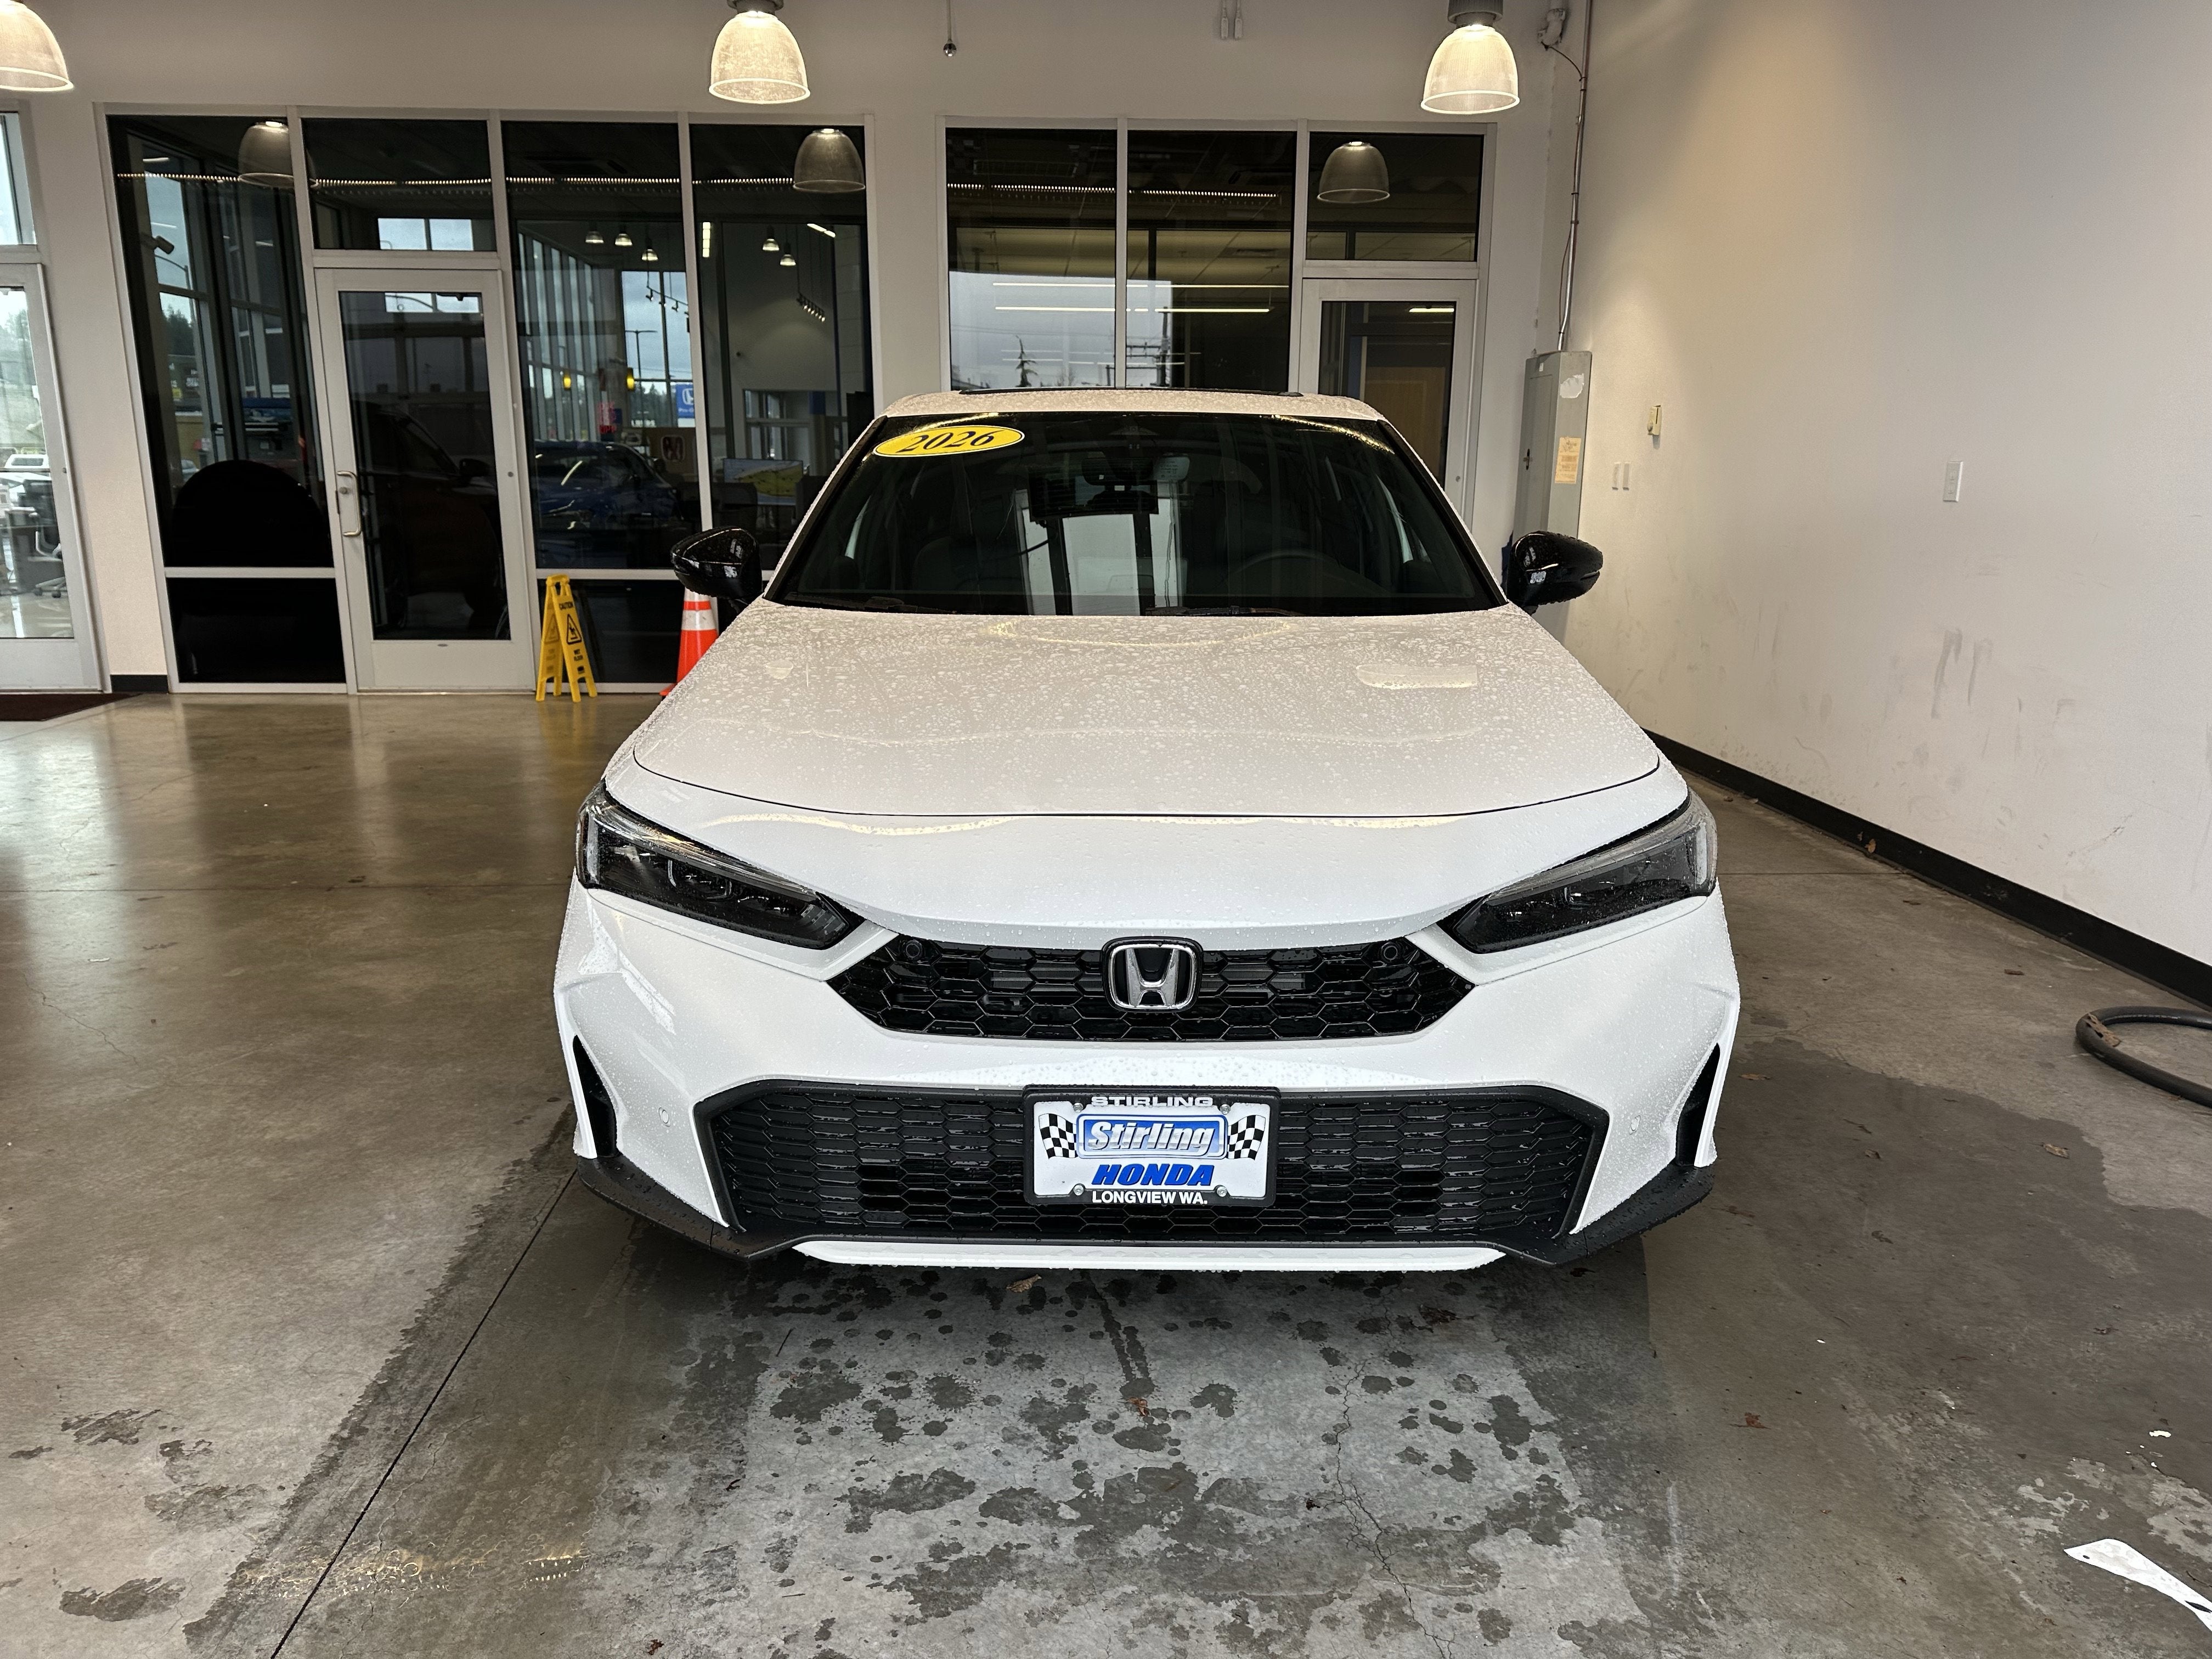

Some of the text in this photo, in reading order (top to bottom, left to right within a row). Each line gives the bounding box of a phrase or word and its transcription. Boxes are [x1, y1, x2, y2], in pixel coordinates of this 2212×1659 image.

[896, 430, 1002, 453] 2026
[1091, 1096, 1214, 1107] STIRLING
[1088, 1121, 1215, 1155] Stirling
[1091, 1163, 1215, 1186] HONDA
[1092, 1190, 1208, 1204] LONGVIEW WA.
